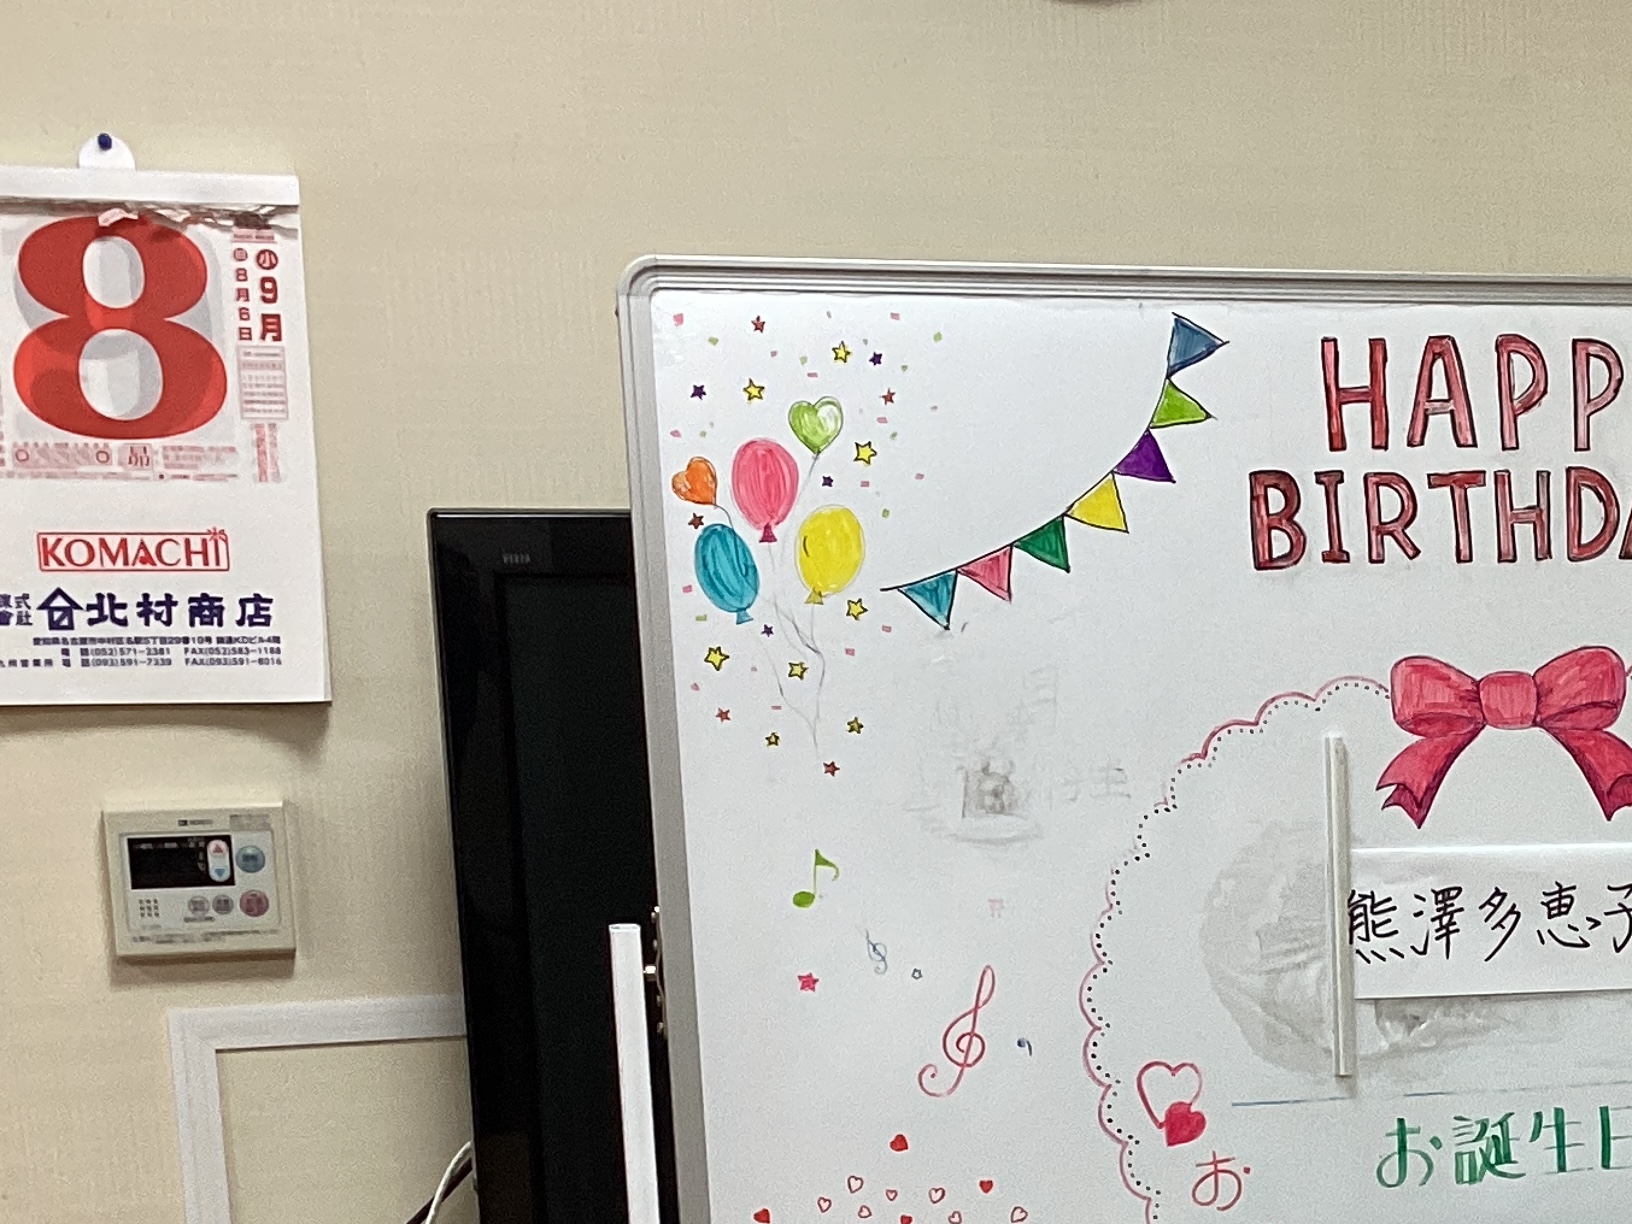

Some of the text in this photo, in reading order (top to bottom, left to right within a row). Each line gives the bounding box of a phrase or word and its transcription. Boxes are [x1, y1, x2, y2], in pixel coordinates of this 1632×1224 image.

[13, 214, 228, 440] 8
[40, 536, 222, 568] KOMACHI
[86, 592, 274, 628] 北村商店
